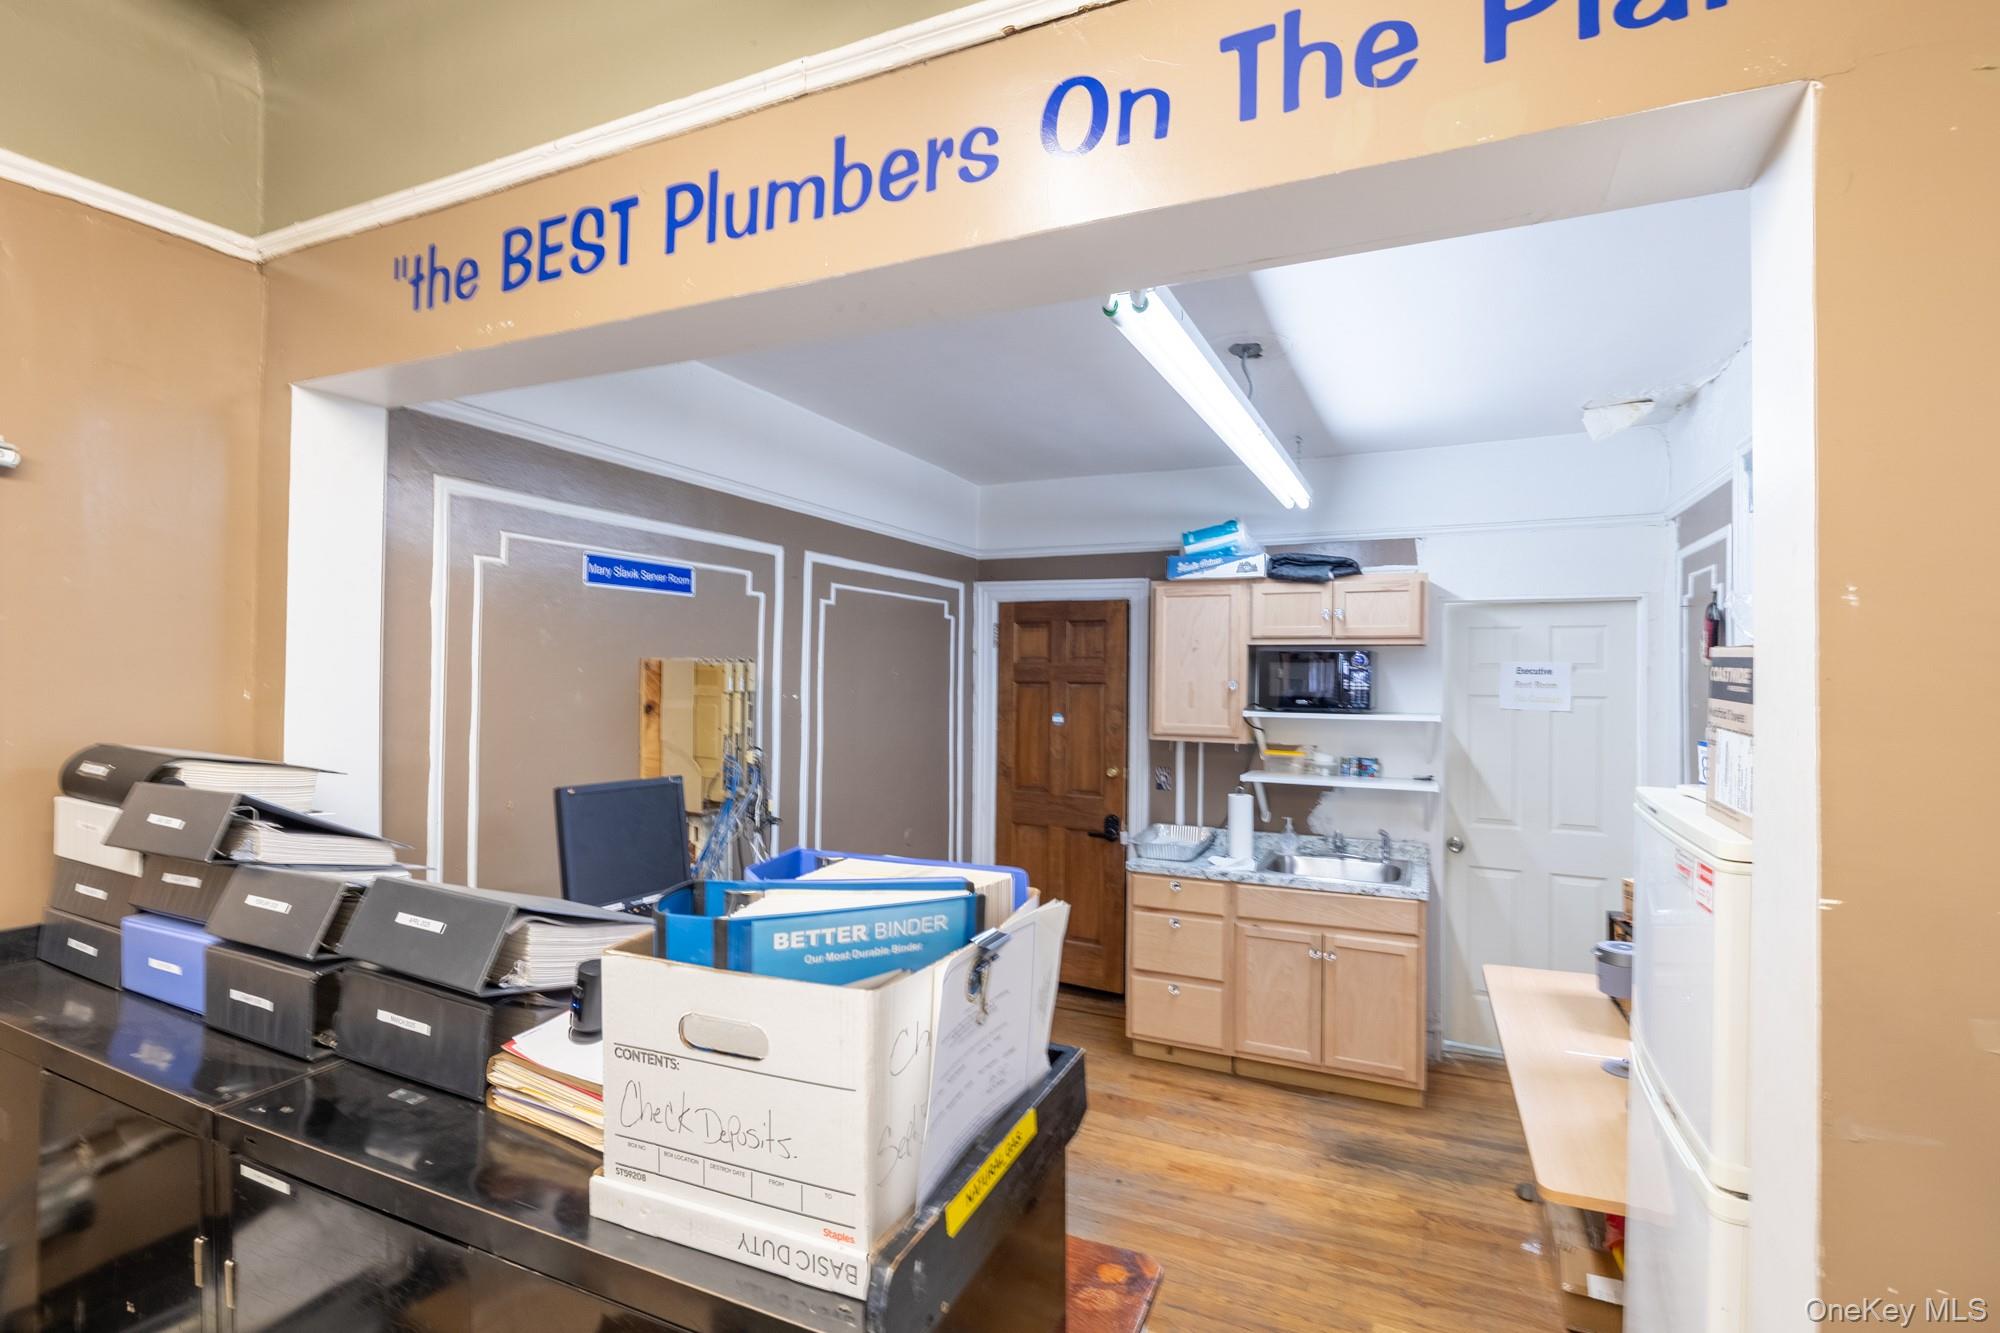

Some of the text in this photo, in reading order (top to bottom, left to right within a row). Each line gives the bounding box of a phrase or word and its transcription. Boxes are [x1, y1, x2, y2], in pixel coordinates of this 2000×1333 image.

[501, 196, 638, 293] BEST
[664, 126, 1000, 256] Plumbers
[1040, 75, 1171, 158] On
[1219, 9, 1419, 122] The
[588, 562, 612, 579] Mary
[667, 572, 690, 585] Room
[773, 914, 949, 950] BETTER BINDER
[804, 954, 824, 964] Our
[825, 950, 851, 963] Most
[852, 946, 889, 960] Durable
[614, 1046, 680, 1071] CONTENTS:
[674, 1154, 700, 1165] LOCATION
[709, 1162, 746, 1178] DESTROY DATE
[768, 1178, 785, 1187] FROM
[824, 1192, 833, 1200] TO
[823, 1227, 856, 1245] Staples
[737, 1232, 858, 1286] BASIC DUTY
